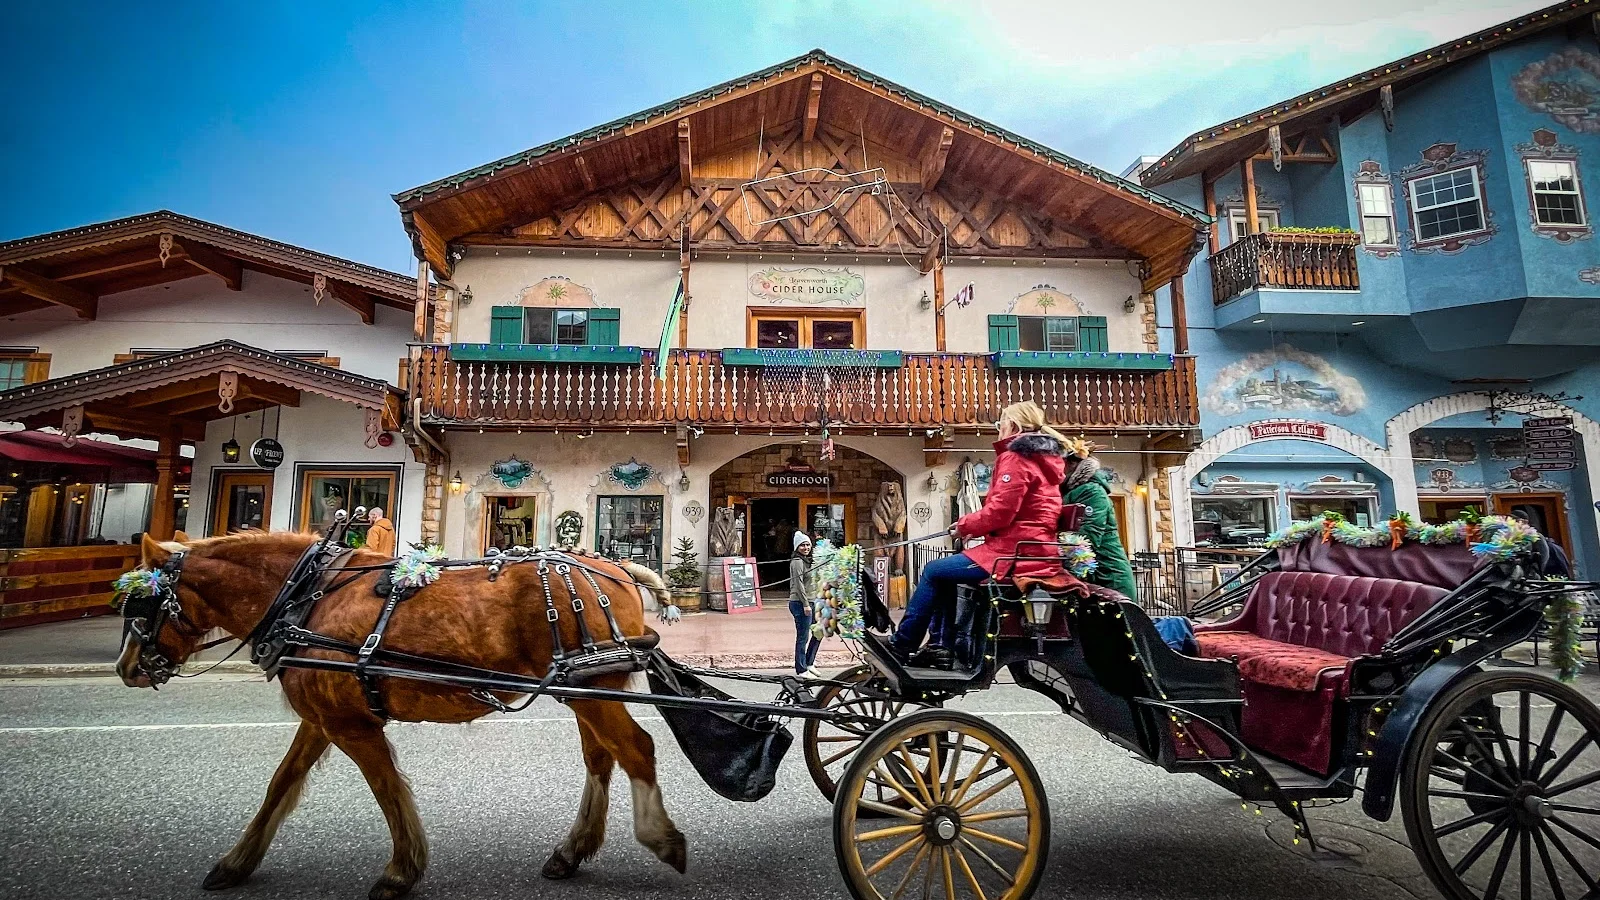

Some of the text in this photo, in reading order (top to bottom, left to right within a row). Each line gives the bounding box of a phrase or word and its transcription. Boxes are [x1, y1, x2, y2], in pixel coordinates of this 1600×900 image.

[788, 276, 828, 285] Leavenworth
[772, 285, 844, 294] CIDER HOUSE
[1257, 423, 1318, 436] Patterson Cellars
[769, 476, 830, 485] CIDER FOOD
[685, 506, 702, 516] 939
[914, 507, 930, 518] 939
